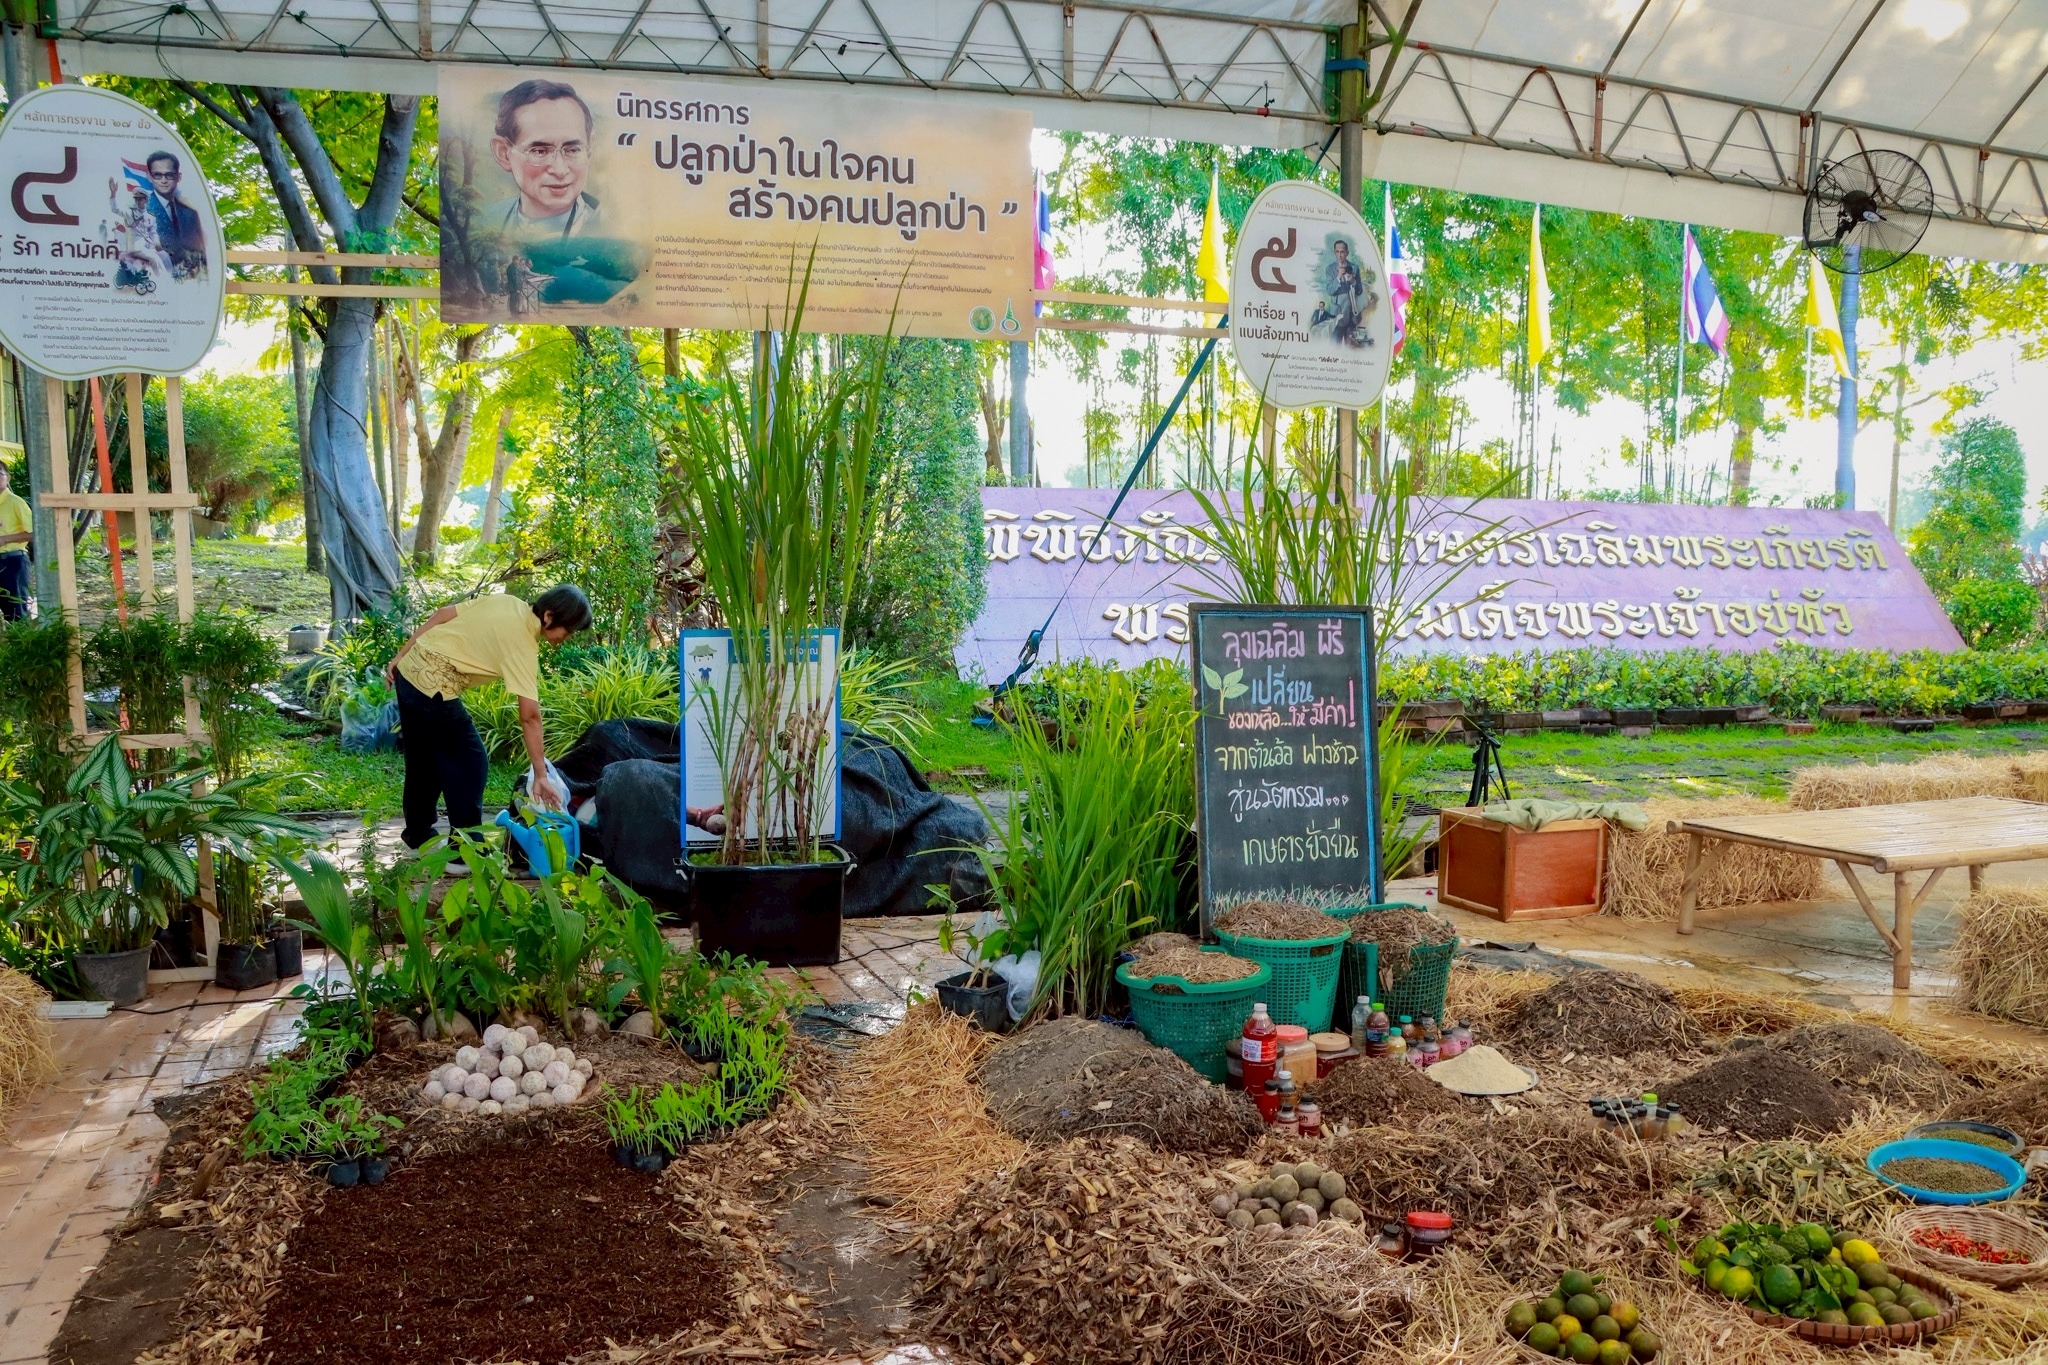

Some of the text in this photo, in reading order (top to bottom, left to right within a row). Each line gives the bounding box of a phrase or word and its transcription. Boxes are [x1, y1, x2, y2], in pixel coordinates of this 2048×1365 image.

[24, 110, 152, 130] หลักการทรงงาน ๒๗ ข้อ
[615, 91, 750, 126] นิทรรศการ
[654, 134, 915, 186] ปลูกป่าในใจคน
[11, 146, 80, 226] ๔
[728, 179, 987, 242] สร้างคนปลูกป่า
[13, 234, 40, 257] รัก
[50, 238, 120, 260] สามัคคี
[1251, 227, 1297, 294] ๕
[1239, 325, 1310, 343] แบบสังฆทาน
[1243, 301, 1300, 326] ทำเรื่อย ๆ
[1221, 622, 1306, 669] ลุงเฉลิม
[1252, 664, 1314, 706] เปลี่ยน
[1214, 733, 1359, 771] จากต้นอ้อ ฟางข้าว
[1243, 816, 1359, 866] เกษตรยั่งยืน
